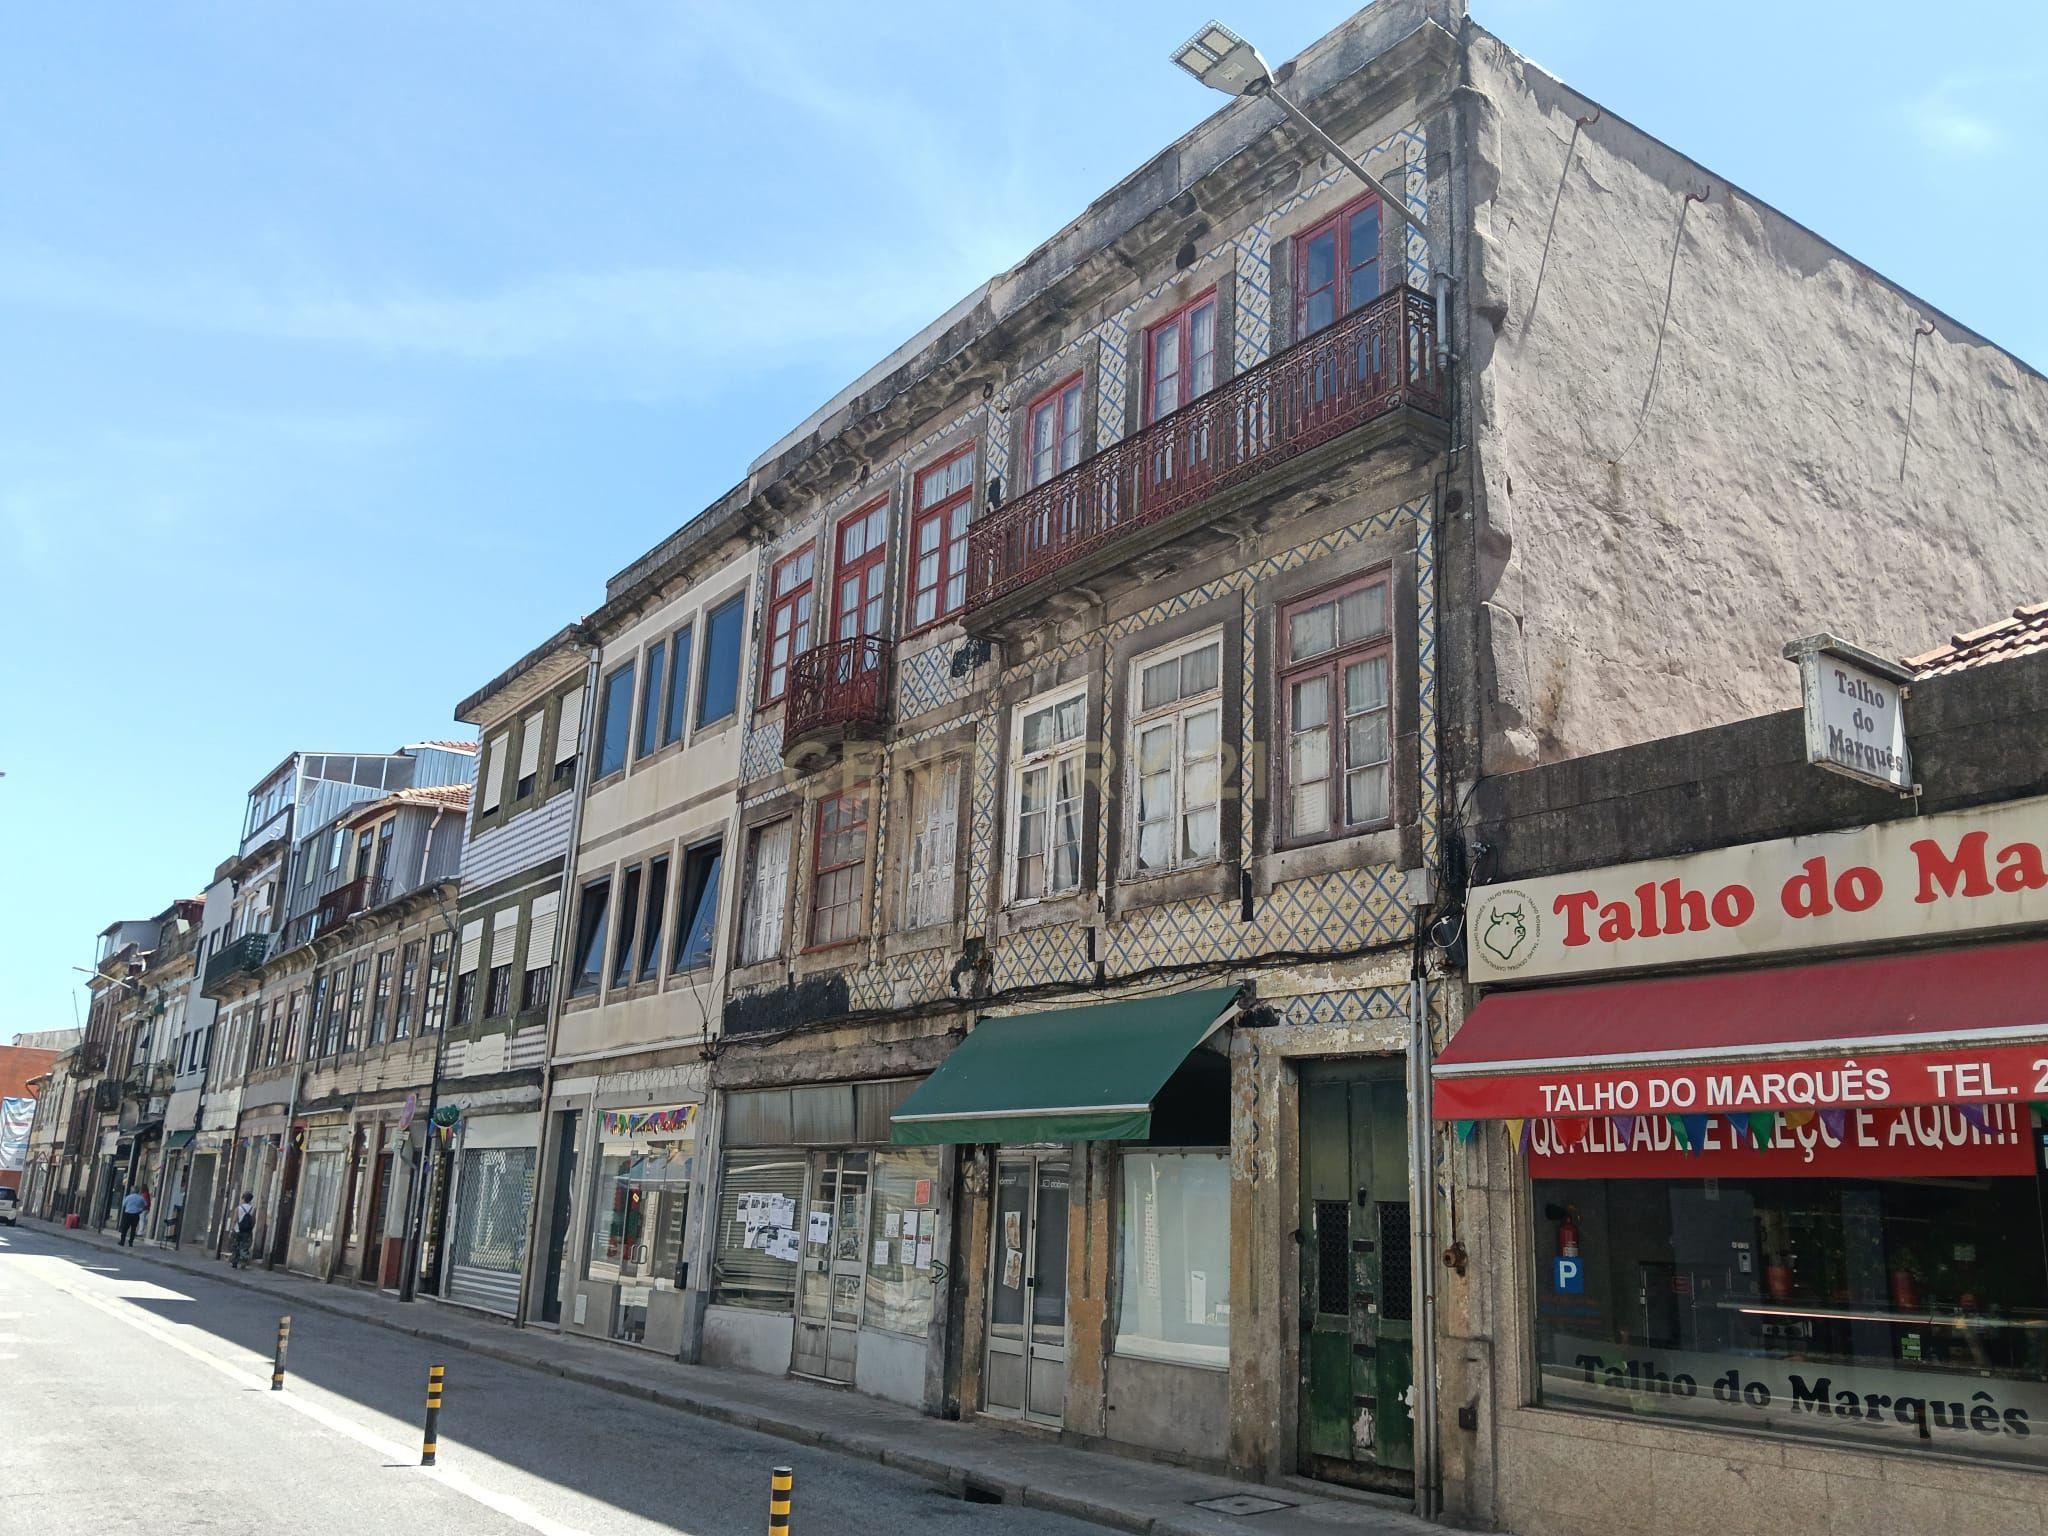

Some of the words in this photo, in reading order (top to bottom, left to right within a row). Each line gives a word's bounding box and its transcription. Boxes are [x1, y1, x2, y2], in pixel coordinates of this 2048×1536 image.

[1834, 669, 1885, 709] Talho
[1853, 708, 1874, 733] do
[1828, 724, 1904, 772] Marquês
[1553, 878, 1755, 946] Talho
[1781, 856, 1883, 918] do
[1909, 831, 2048, 904] Ma
[1539, 1080, 1639, 1112] TALHO
[1648, 1077, 1696, 1108] DO
[1706, 1061, 1891, 1105] MARQUÊS
[1927, 1063, 2018, 1097] TEL.
[1531, 1116, 1693, 1157] QLIAD
[1559, 1261, 1577, 1288] P
[1575, 1354, 1698, 1397] Talho
[1713, 1370, 1771, 1407] do
[1788, 1375, 2031, 1439] Marquês
